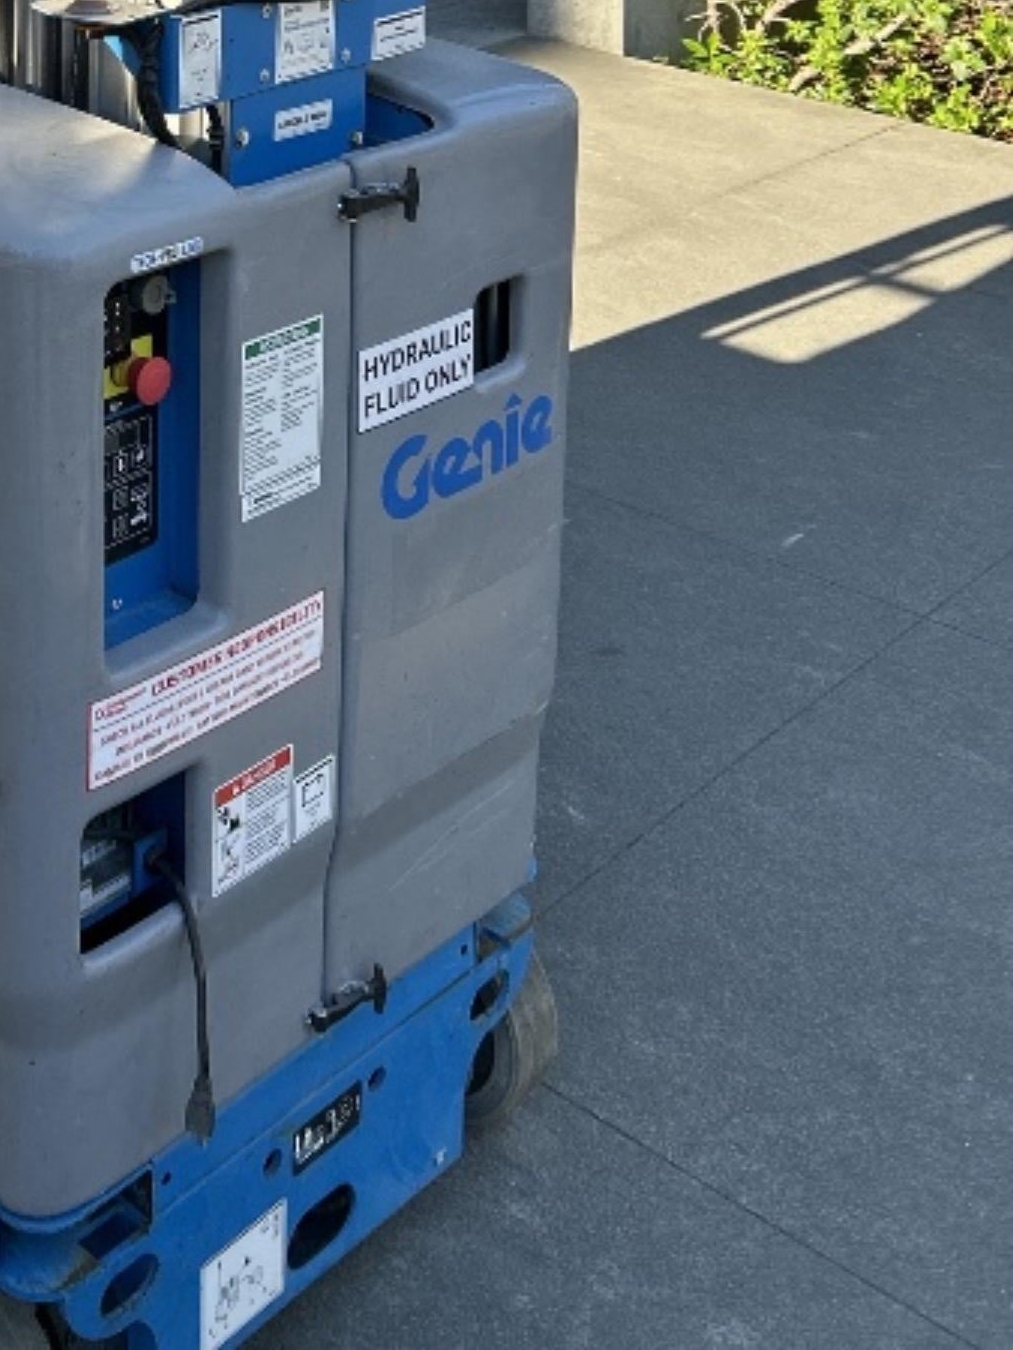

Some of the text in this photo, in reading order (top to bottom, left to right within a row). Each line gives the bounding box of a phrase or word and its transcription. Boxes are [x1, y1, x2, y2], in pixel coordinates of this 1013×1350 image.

[364, 320, 472, 381] HYDRAULIC
[364, 353, 472, 418] FLUID ONLY
[381, 393, 554, 520] Genie
